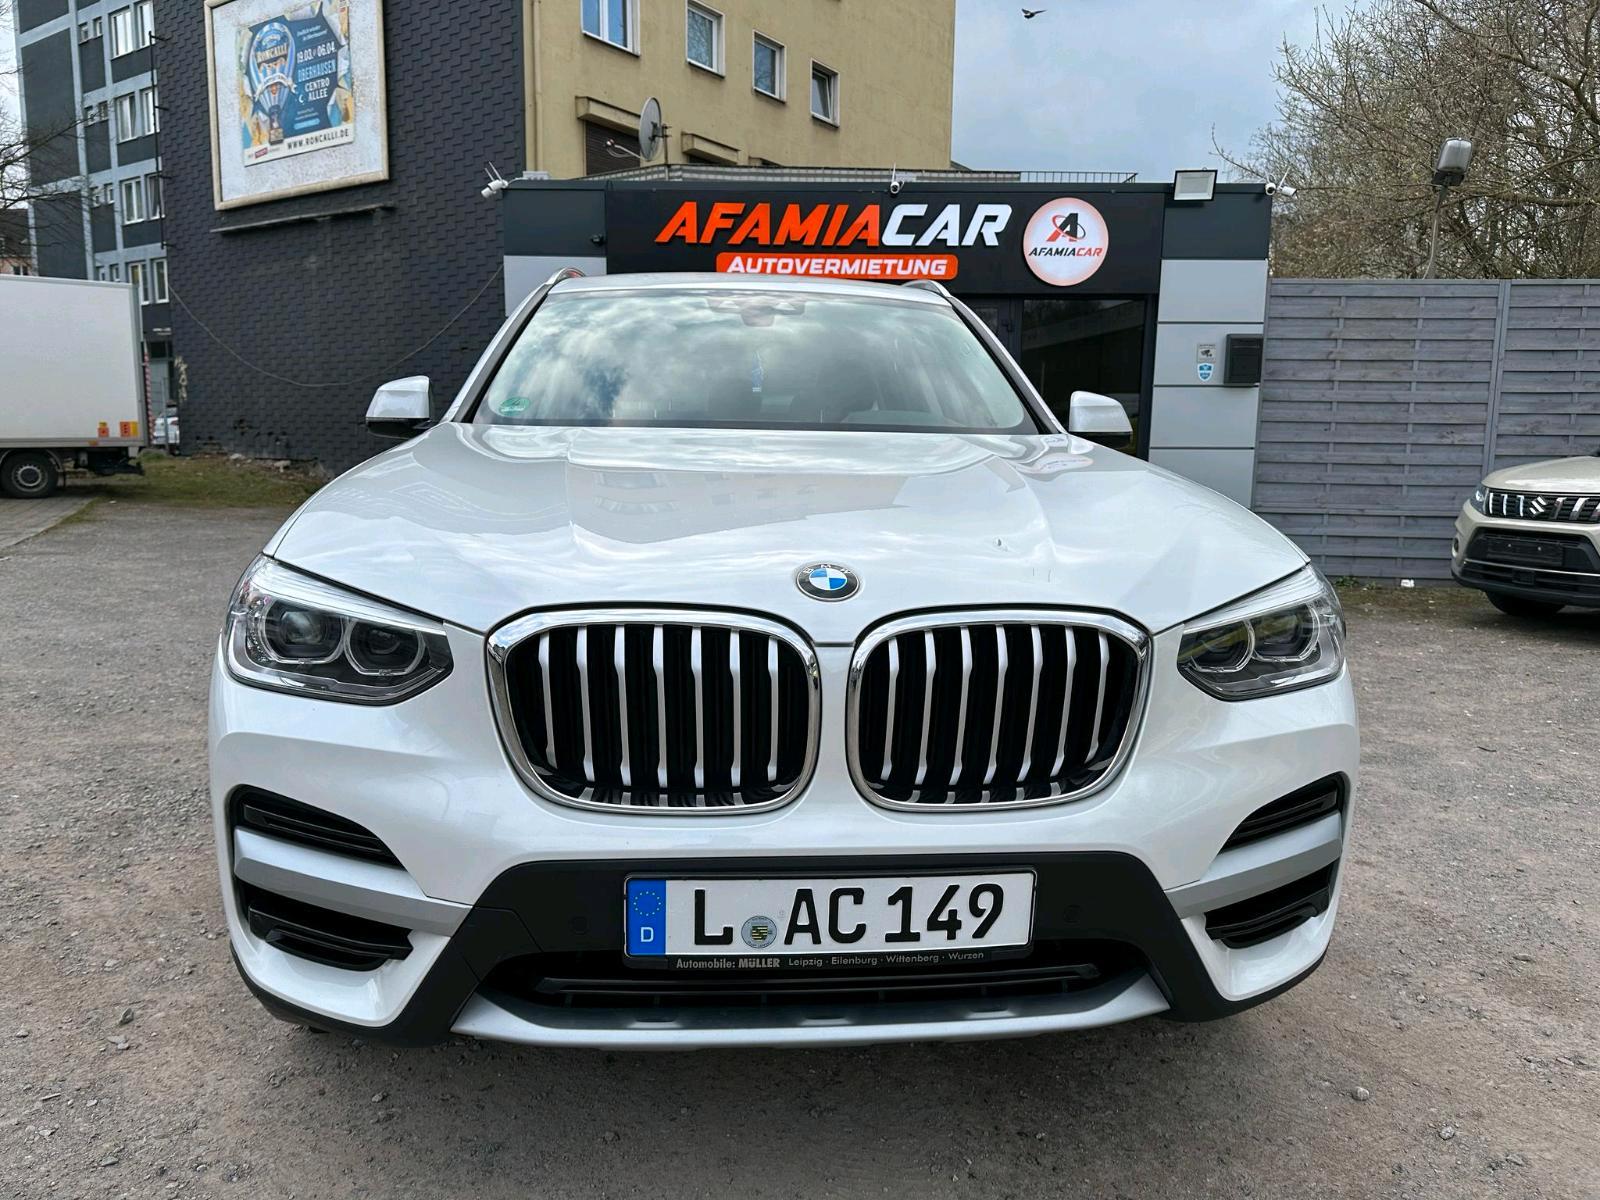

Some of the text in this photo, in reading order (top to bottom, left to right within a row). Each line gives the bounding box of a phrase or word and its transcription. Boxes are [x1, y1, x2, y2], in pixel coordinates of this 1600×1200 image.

[298, 59, 336, 82] OBERHAUSEN
[304, 77, 330, 92] CENTRO
[308, 88, 329, 102] ALLEE
[287, 128, 349, 150] WWW.RONCALLI.DE
[1029, 248, 1103, 257] AFAMIACAR
[727, 256, 947, 275] AUTOVERMIETUNG
[695, 889, 733, 945] L
[784, 887, 866, 945] AC
[885, 883, 1004, 943] 149
[641, 926, 654, 942] D
[676, 951, 984, 969] Automobile: MÜLLER Leipzig Eilenburg Wittenberg Wurzen
